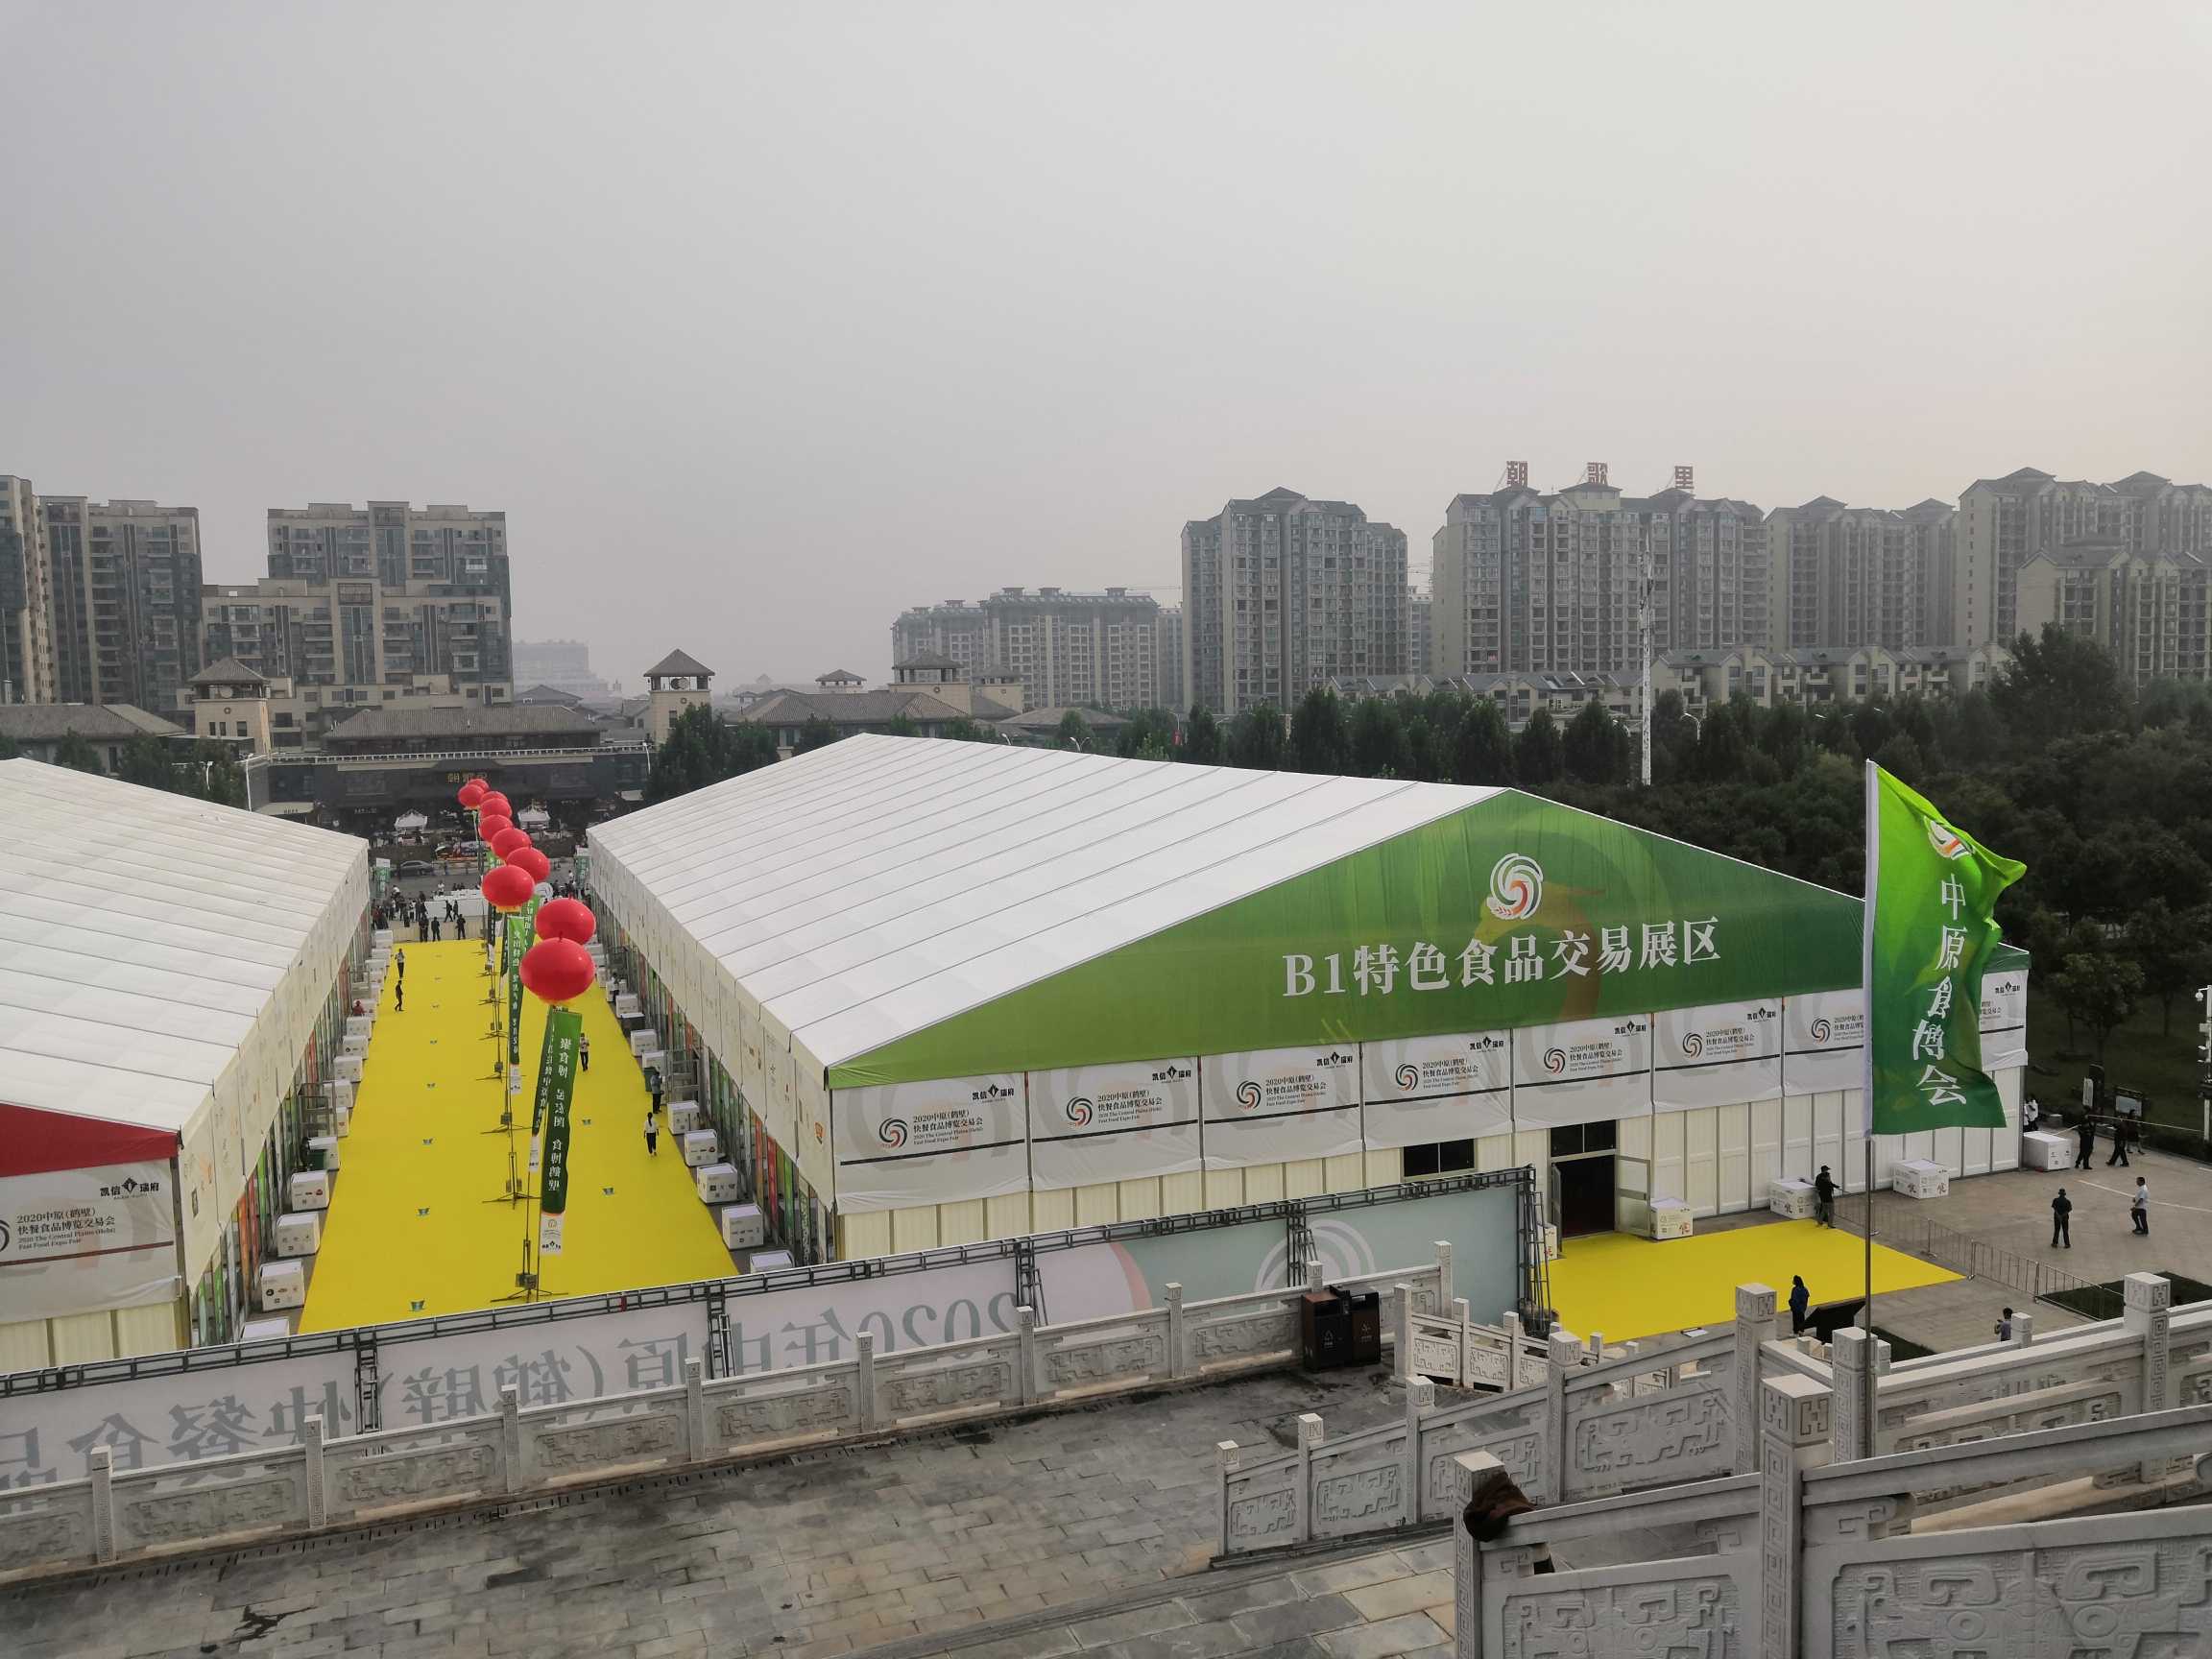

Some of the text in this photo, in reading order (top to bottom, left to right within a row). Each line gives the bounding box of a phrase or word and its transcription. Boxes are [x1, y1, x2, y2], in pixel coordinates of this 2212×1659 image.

[1283, 916, 1720, 997] B1特色食品交易展区
[1913, 873, 1966, 1106] 中原食博会
